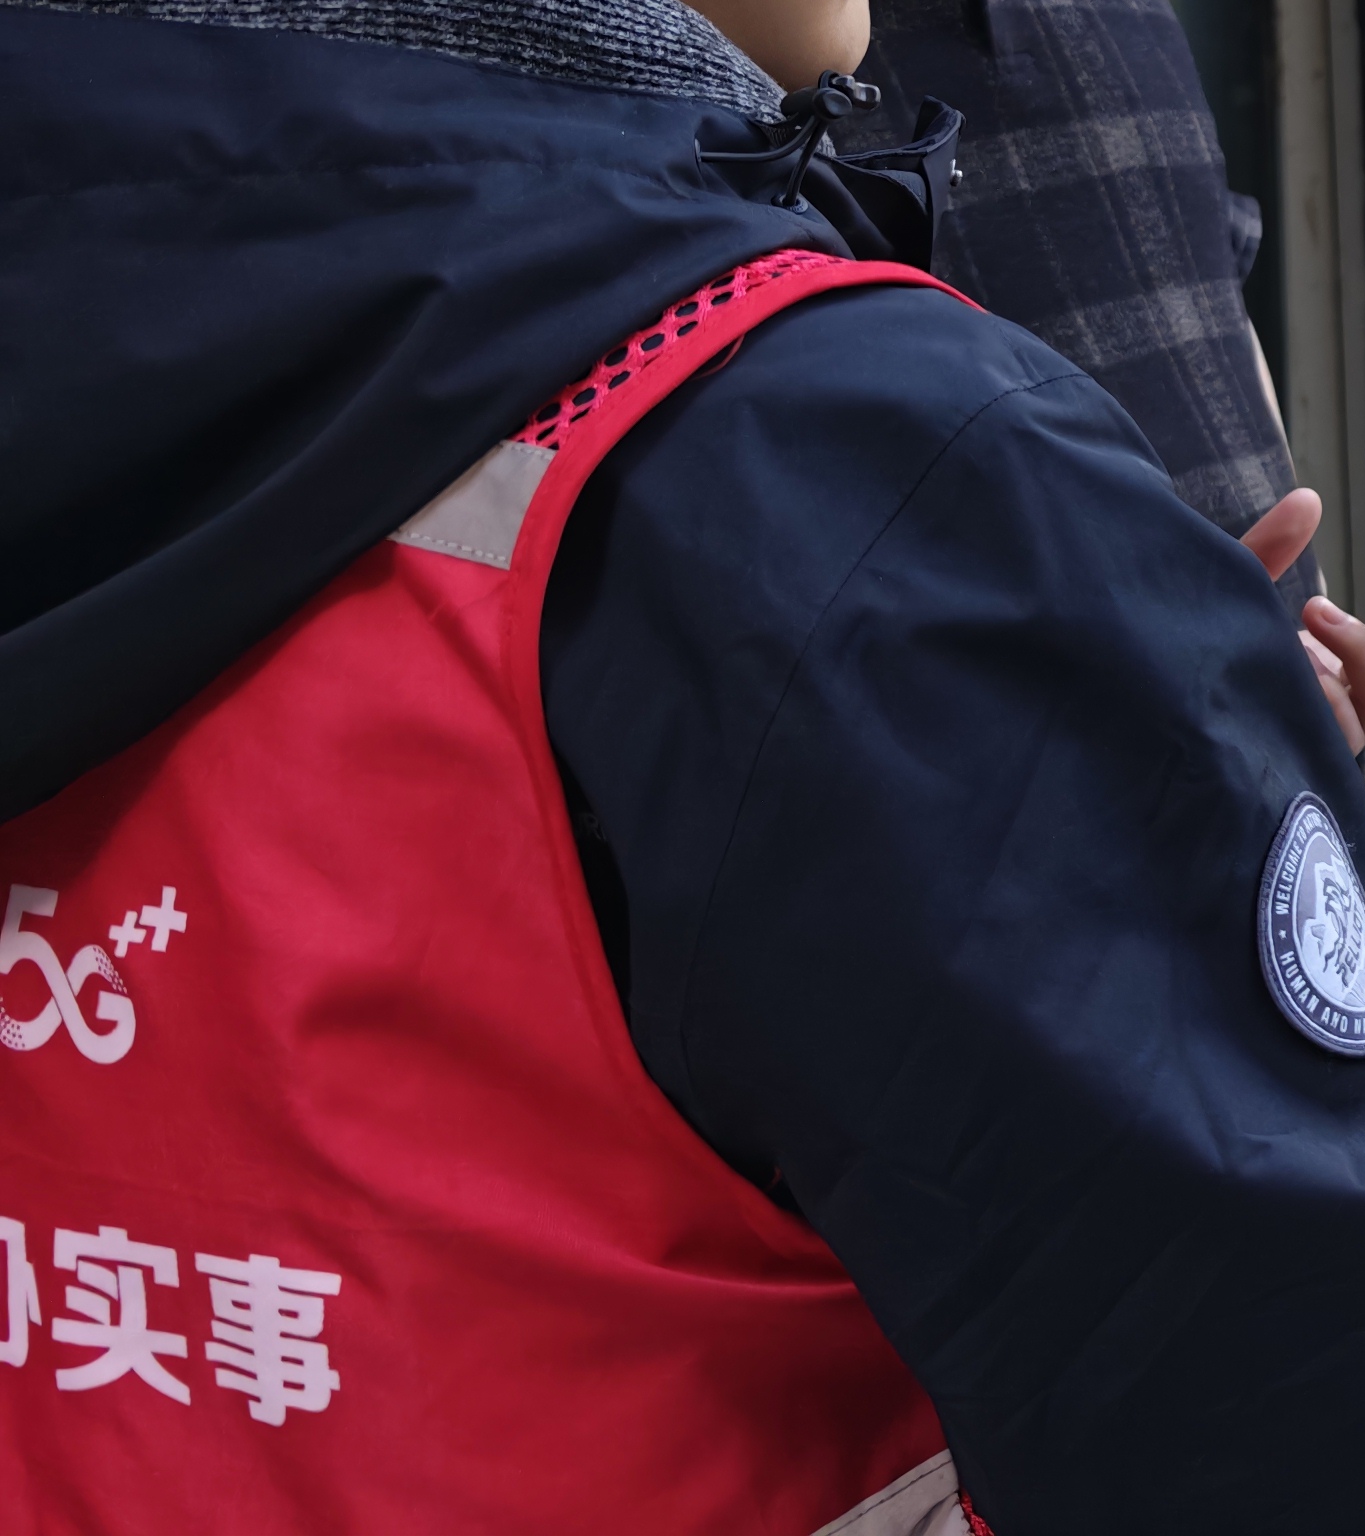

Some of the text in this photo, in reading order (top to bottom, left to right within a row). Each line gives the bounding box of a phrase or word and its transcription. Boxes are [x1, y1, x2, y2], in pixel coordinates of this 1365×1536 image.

[1275, 840, 1303, 915] WELCOME
[1279, 950, 1321, 1014] HUMAN
[1321, 1005, 1349, 1035] AND
